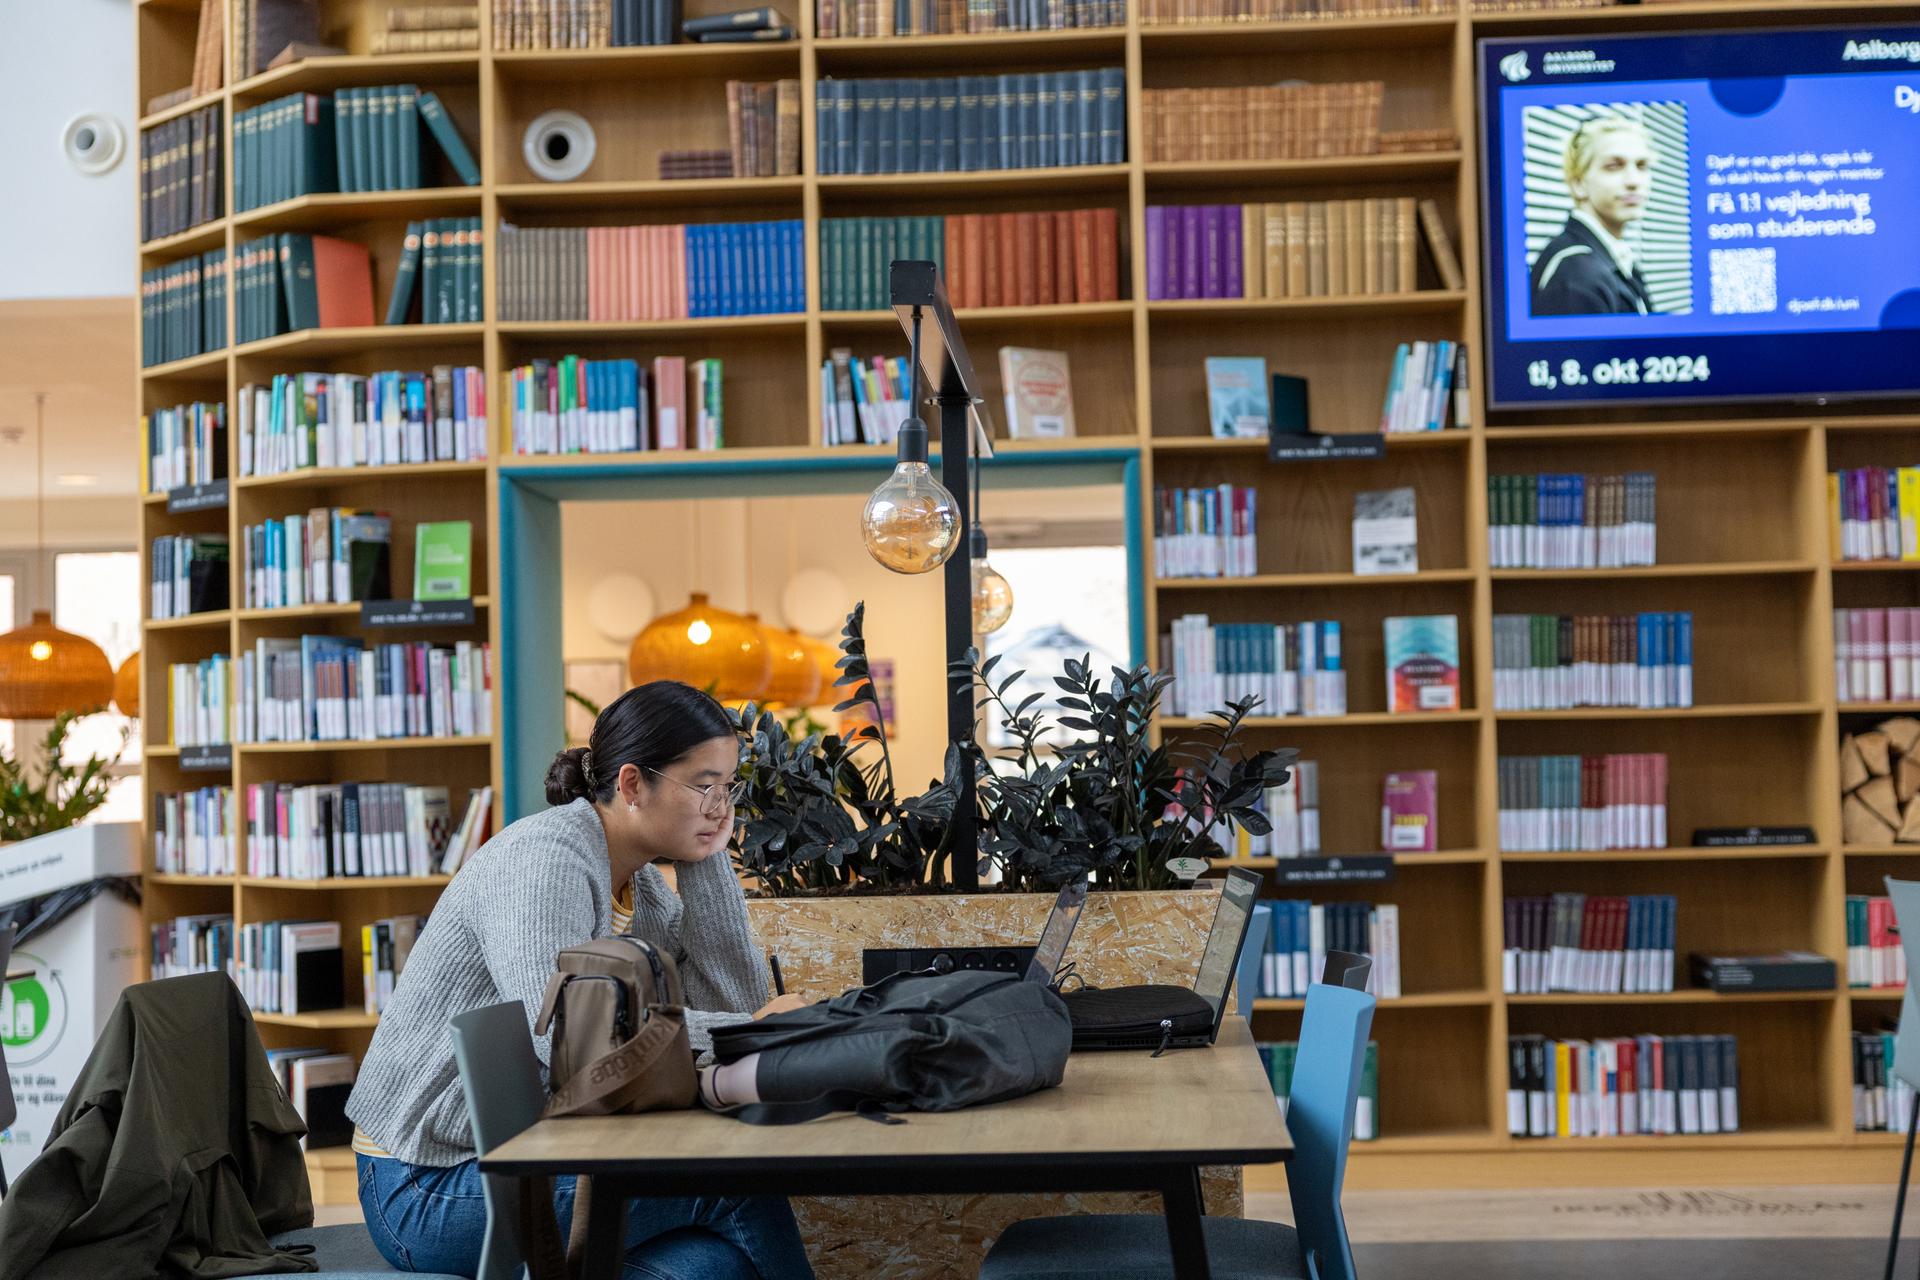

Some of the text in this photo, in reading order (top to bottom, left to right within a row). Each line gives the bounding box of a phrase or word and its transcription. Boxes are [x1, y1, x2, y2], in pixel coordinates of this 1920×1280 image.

[1842, 39, 1920, 63] Aalborg
[1707, 191, 1735, 214] Få
[1765, 189, 1871, 217] vejledning
[1707, 215, 1876, 240] som studerende
[1528, 355, 1711, 390] ti, 8. okt 2024
